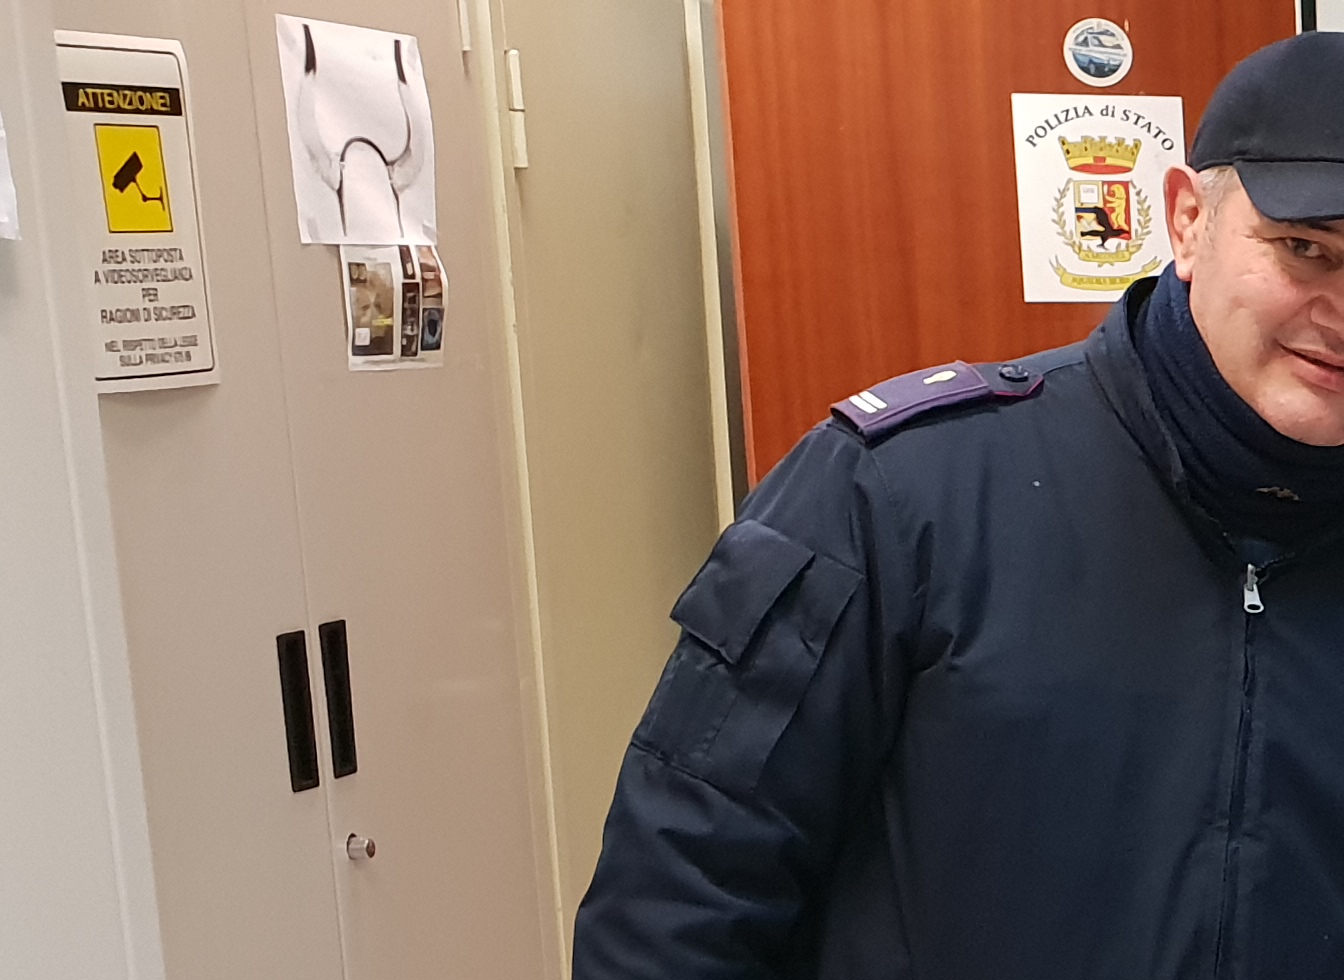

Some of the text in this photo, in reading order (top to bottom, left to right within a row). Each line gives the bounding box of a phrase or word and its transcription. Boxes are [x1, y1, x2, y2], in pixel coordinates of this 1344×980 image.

[1025, 104, 1174, 151] POLIZIA di STATO
